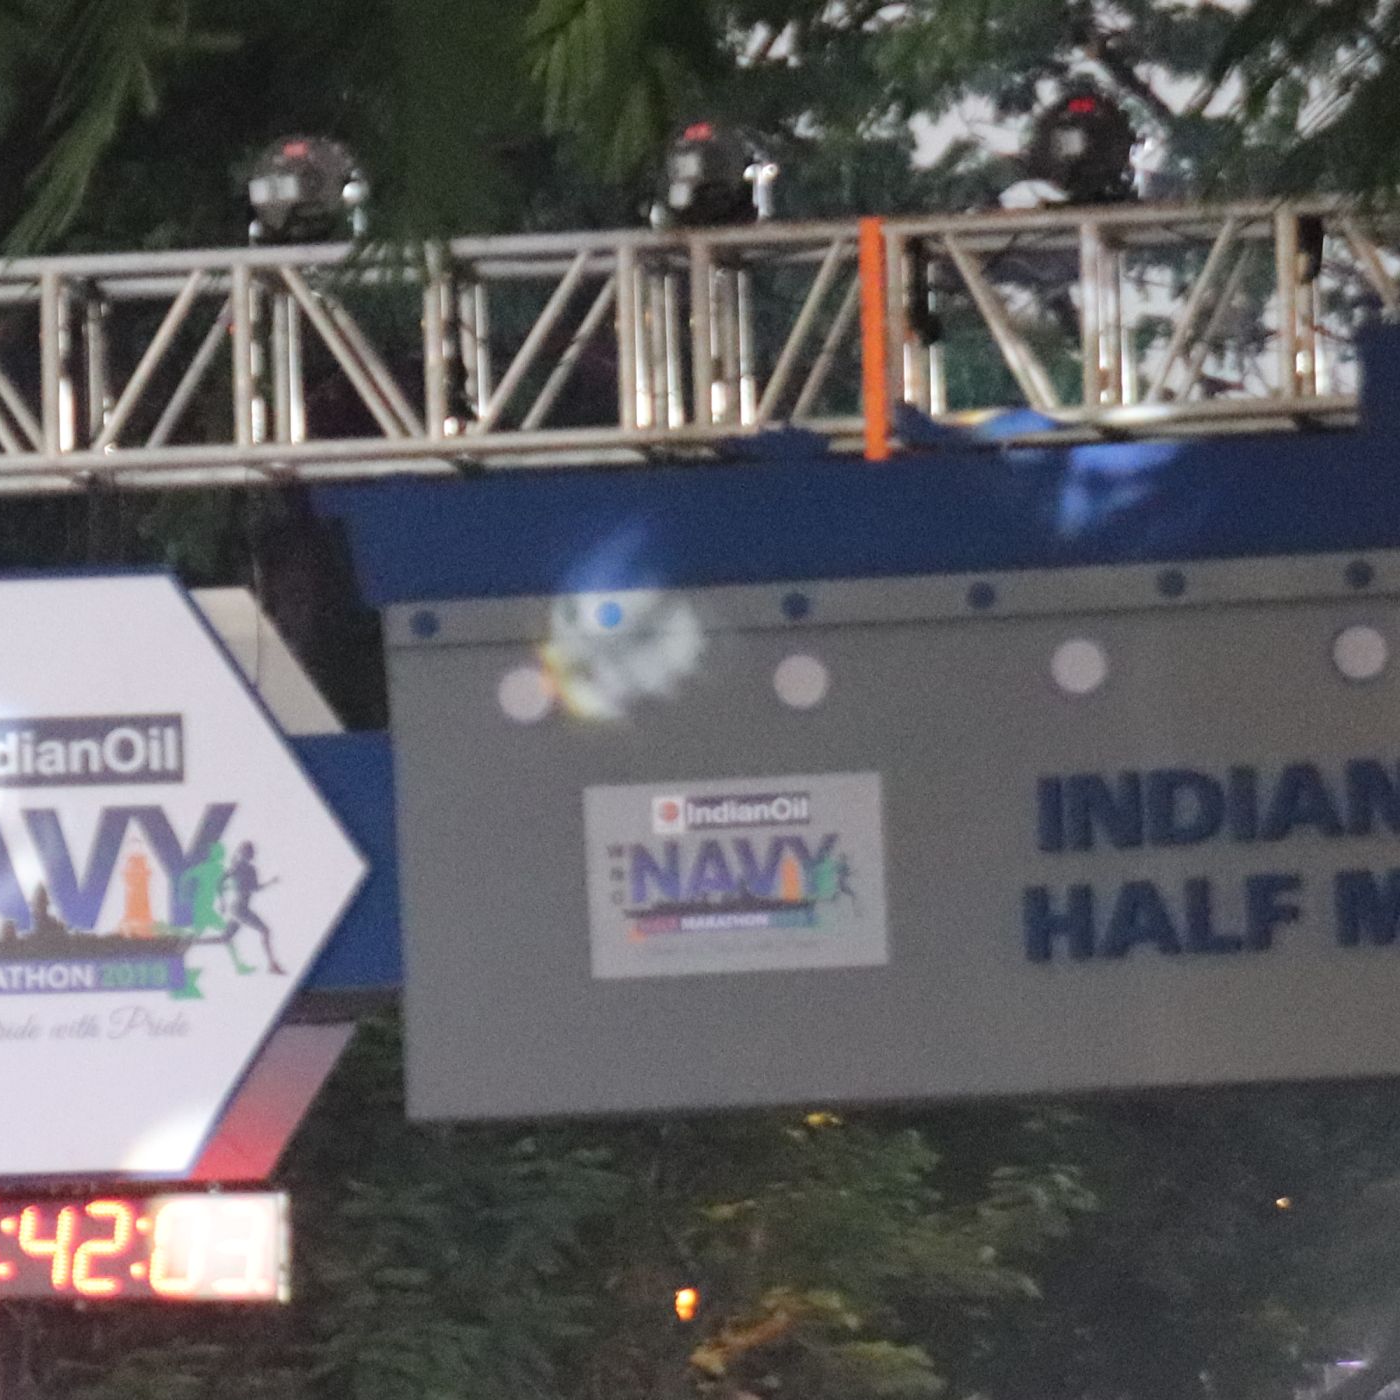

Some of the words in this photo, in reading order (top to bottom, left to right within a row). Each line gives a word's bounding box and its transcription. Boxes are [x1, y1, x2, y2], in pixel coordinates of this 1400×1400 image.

[686, 797, 809, 824] IndianOil
[629, 833, 839, 904] NAVY
[1022, 872, 1302, 964] HALF
